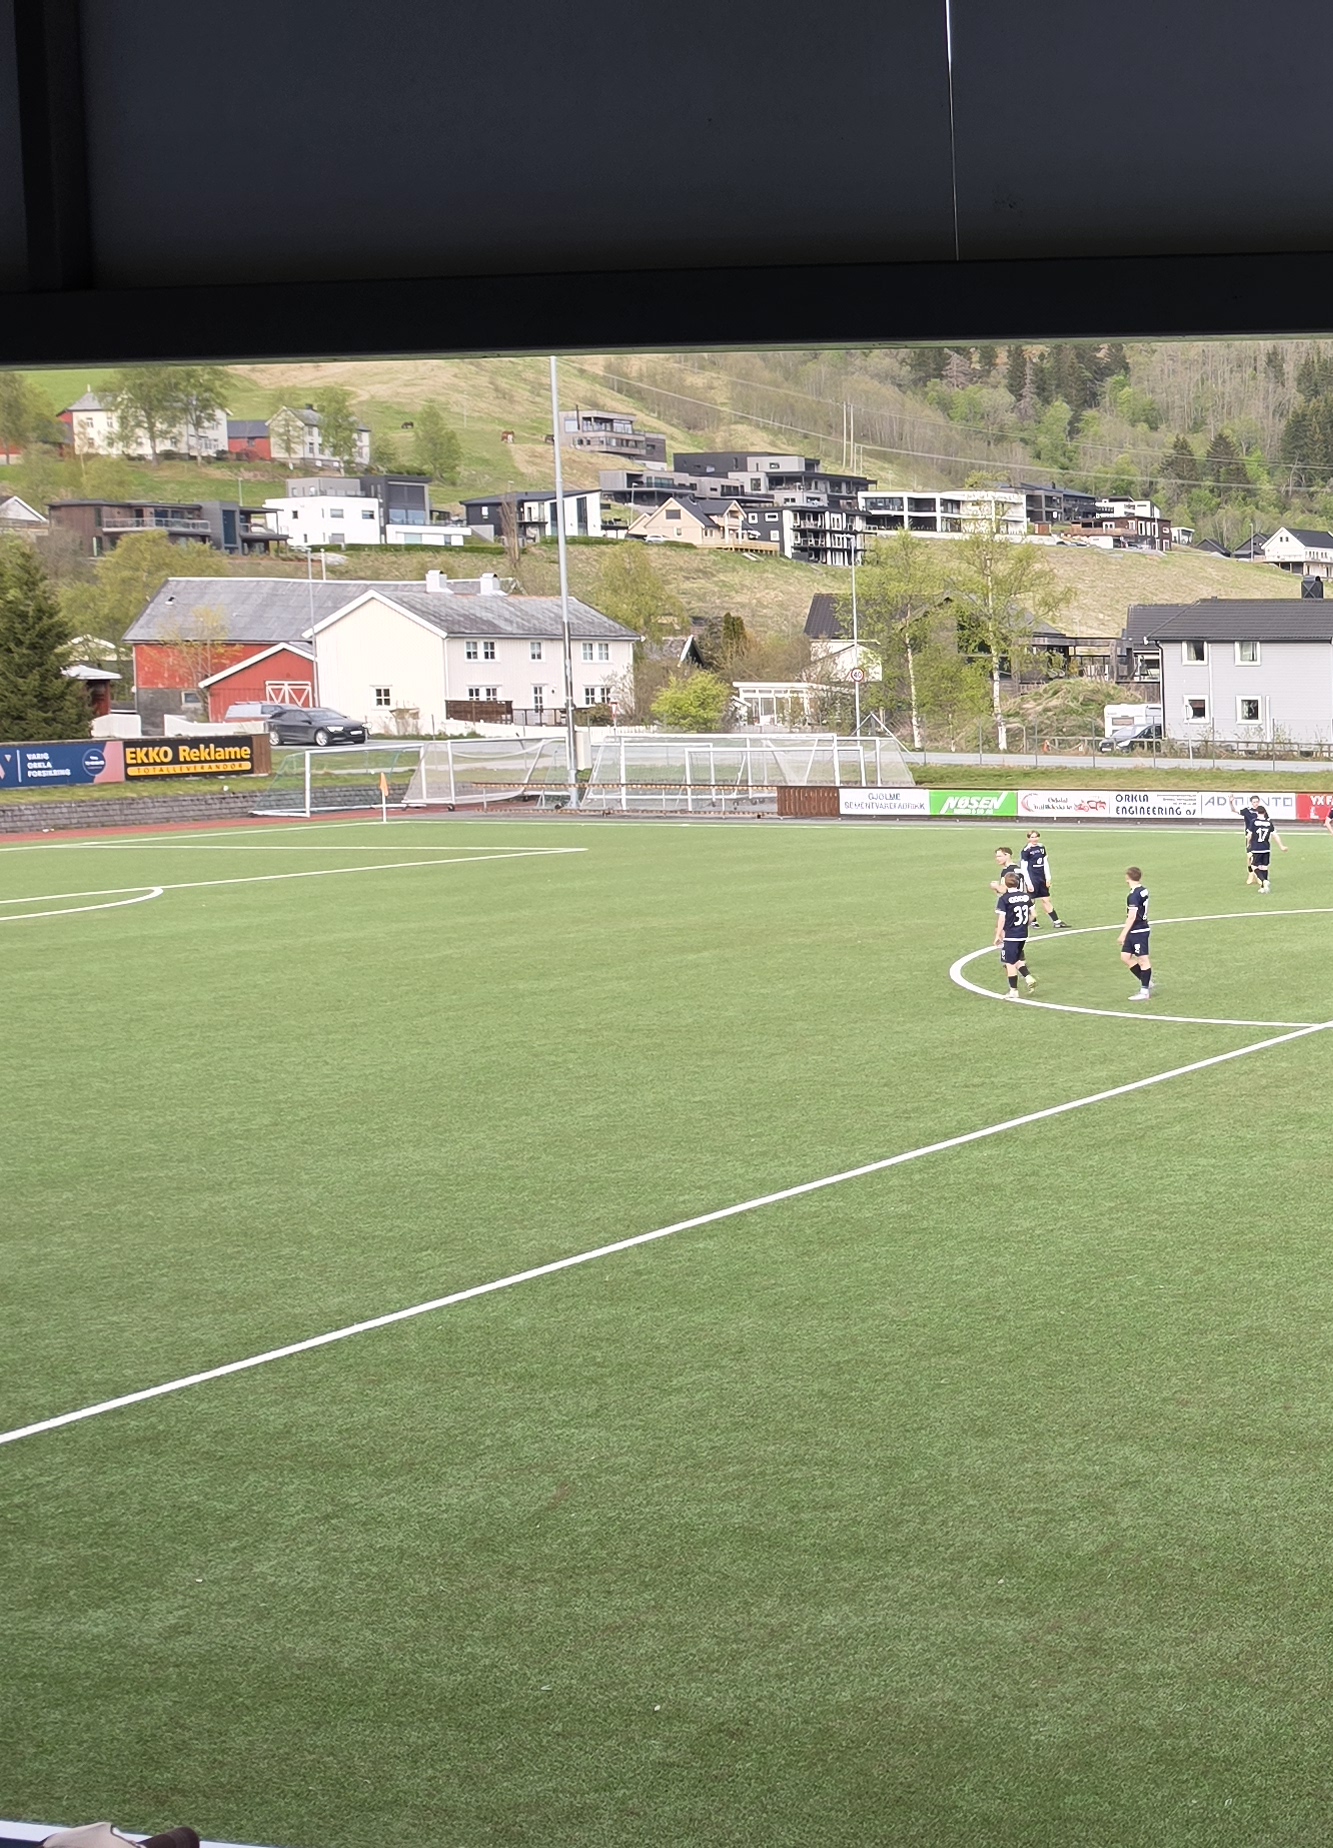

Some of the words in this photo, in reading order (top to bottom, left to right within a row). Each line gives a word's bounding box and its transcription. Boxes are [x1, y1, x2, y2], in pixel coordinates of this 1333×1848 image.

[125, 747, 173, 765] EKKO
[179, 745, 251, 762] Reklame
[939, 792, 1008, 814] NØSEN
[1310, 795, 1325, 806] YX
[1115, 805, 1182, 816] ENGINEERING
[1255, 827, 1270, 842] 17
[1013, 904, 1029, 926] 33
